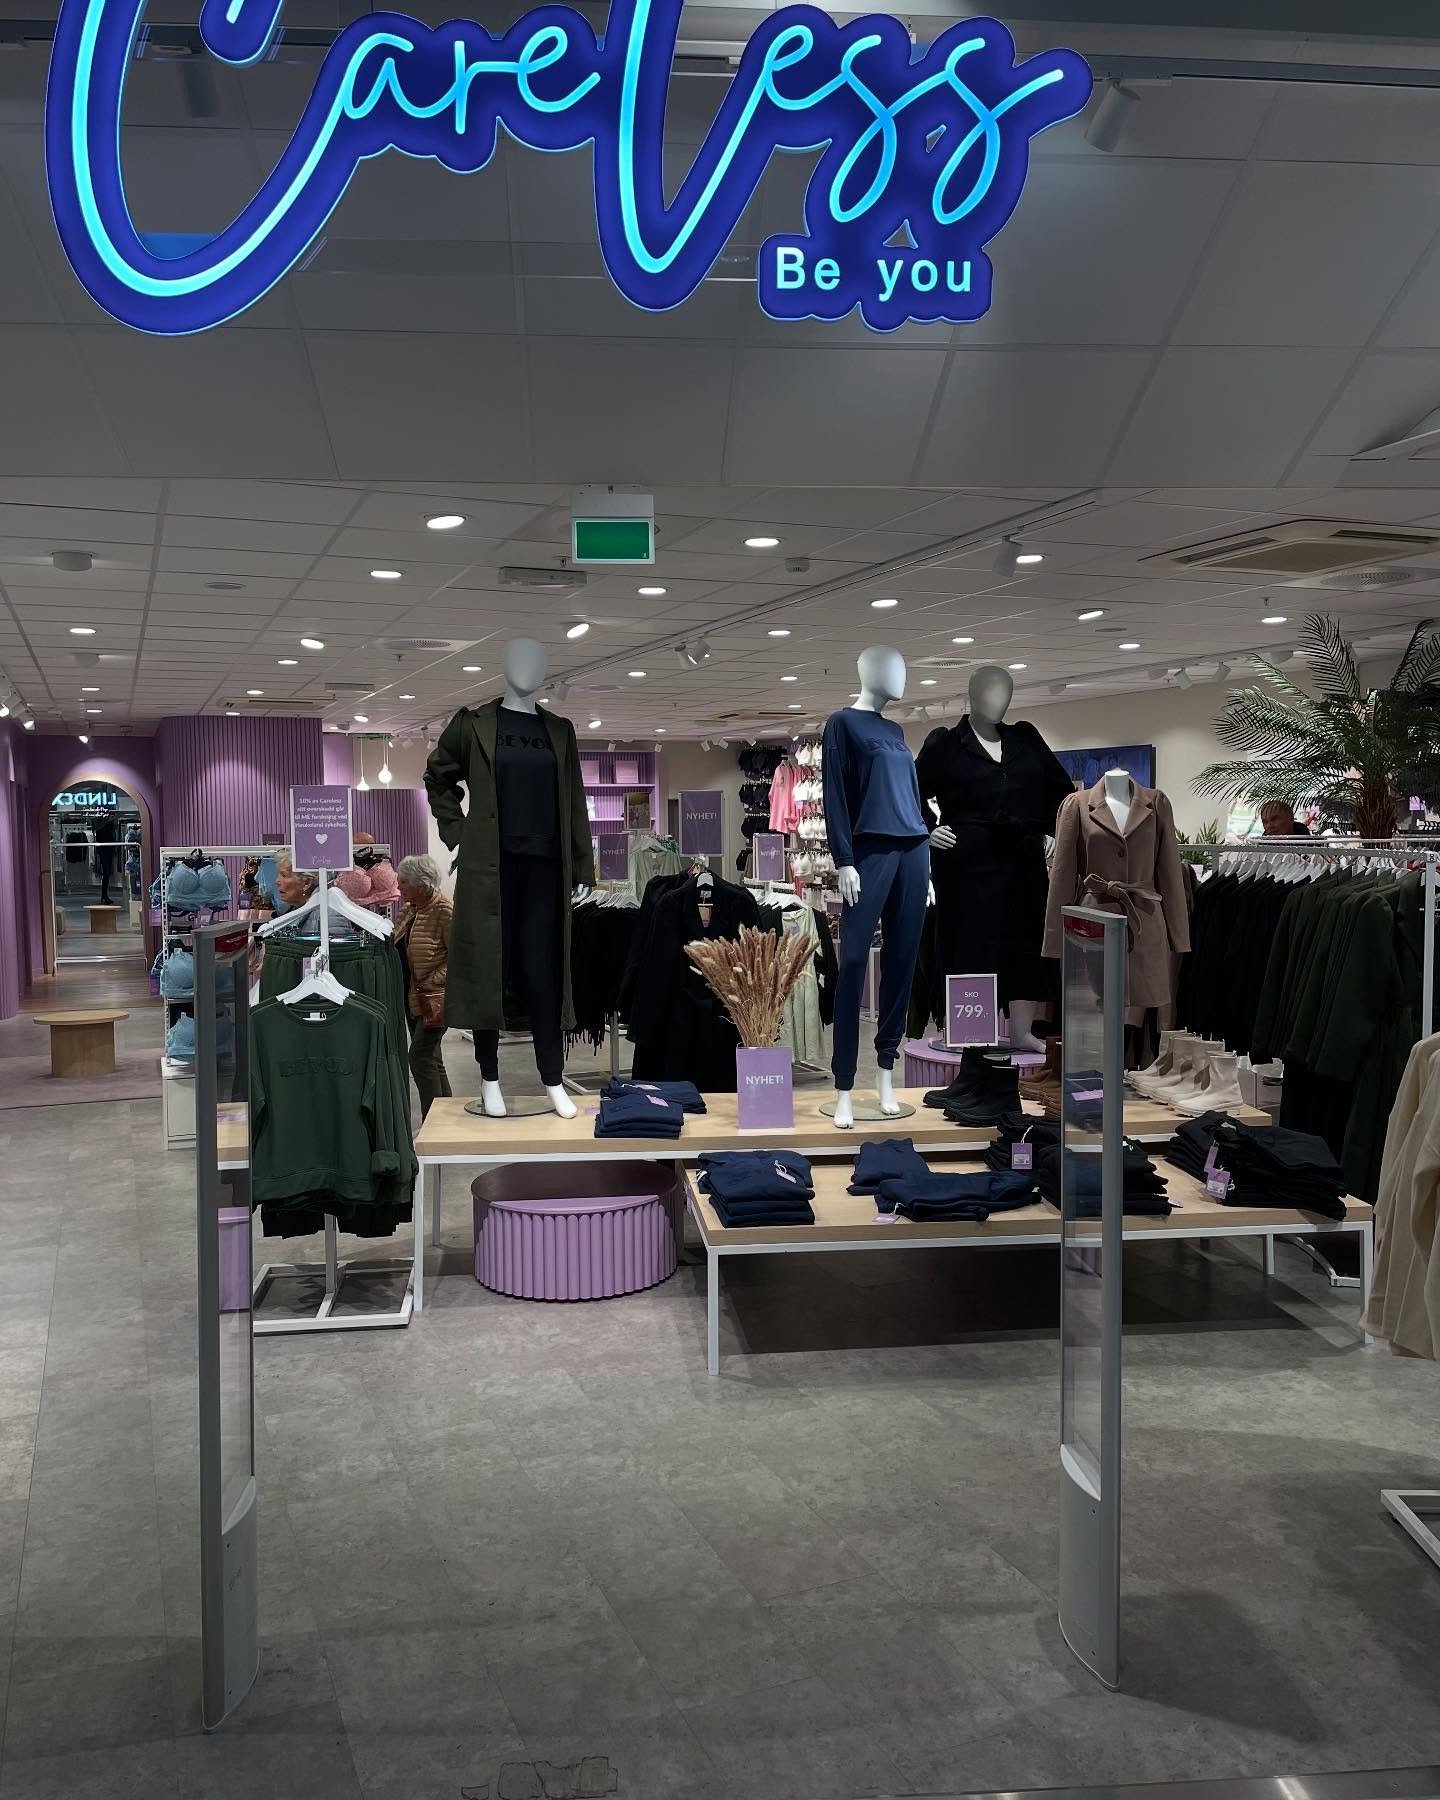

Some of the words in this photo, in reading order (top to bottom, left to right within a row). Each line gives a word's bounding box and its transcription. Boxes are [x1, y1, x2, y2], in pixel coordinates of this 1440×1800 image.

[776, 246, 840, 290] Be
[876, 259, 971, 302] you
[686, 812, 717, 820] NYHET!
[745, 1075, 784, 1085] NYHET!
